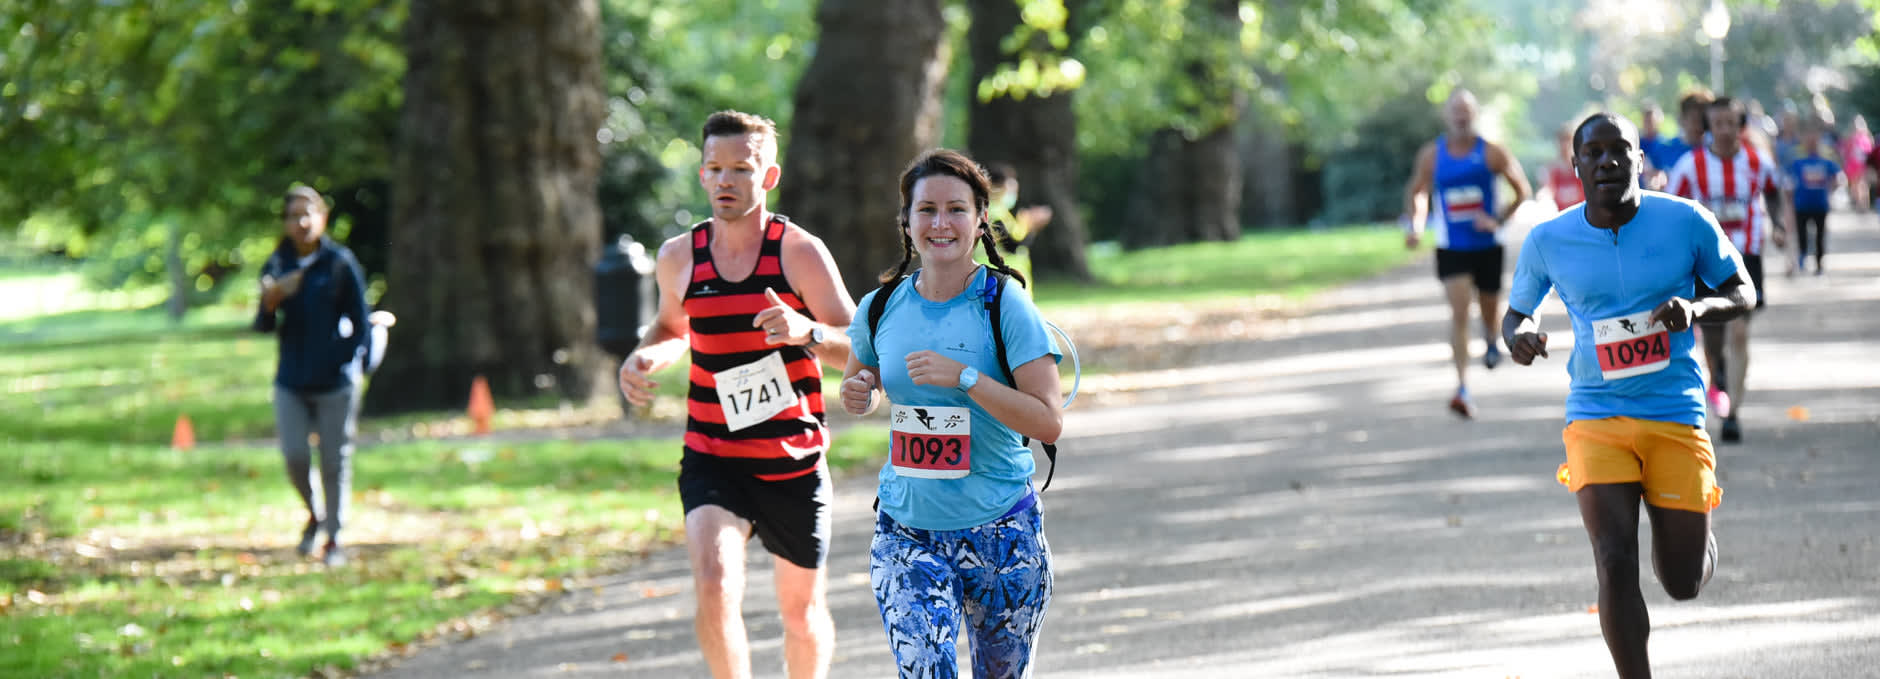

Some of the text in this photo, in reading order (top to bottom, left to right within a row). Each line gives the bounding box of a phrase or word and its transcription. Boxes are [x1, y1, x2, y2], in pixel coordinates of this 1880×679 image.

[1604, 334, 1666, 367] 1094
[728, 377, 781, 414] 1741
[900, 435, 962, 466] 1093
